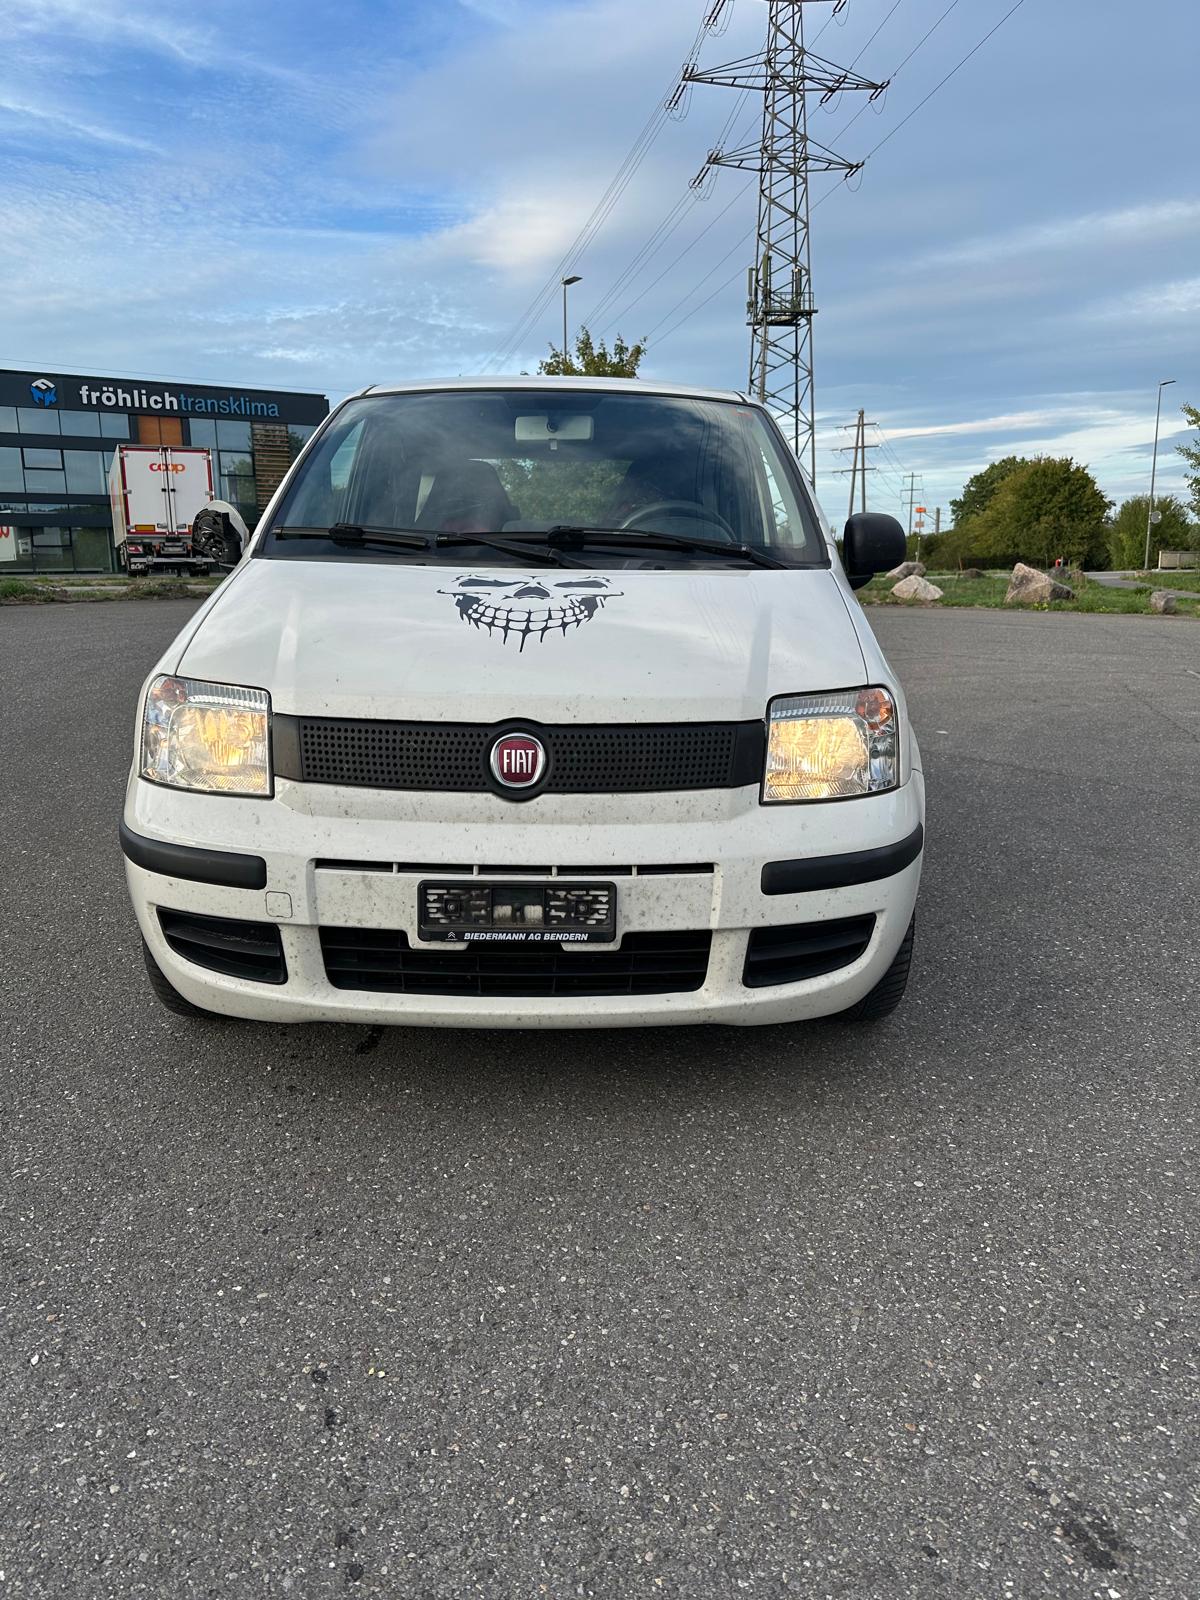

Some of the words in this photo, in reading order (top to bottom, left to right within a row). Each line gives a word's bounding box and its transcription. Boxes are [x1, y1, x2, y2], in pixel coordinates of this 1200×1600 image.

[149, 463, 186, 474] coop
[503, 749, 536, 774] FIAT
[463, 932, 526, 941] BIEDERMANN
[527, 932, 541, 941] AG
[543, 932, 588, 941] BENDERN
